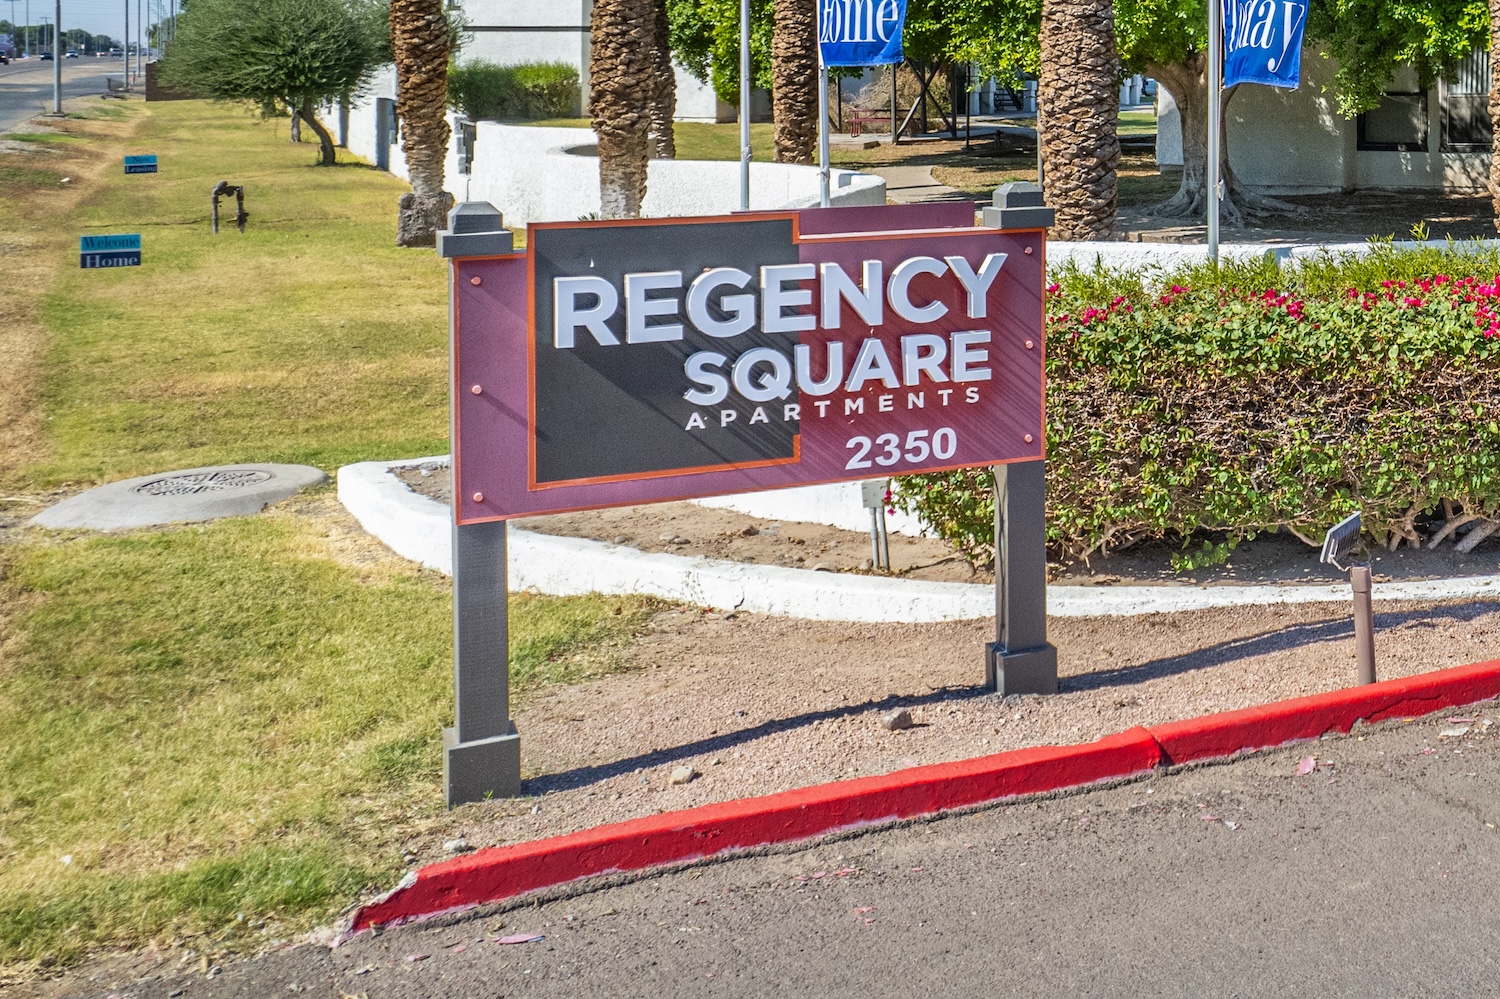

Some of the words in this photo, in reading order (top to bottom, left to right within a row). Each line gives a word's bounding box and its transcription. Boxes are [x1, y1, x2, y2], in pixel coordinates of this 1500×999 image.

[125, 165, 157, 173] Leasing
[83, 236, 139, 249] Welcome
[86, 255, 138, 268] Home
[552, 252, 1009, 349] REGENCY
[683, 330, 993, 406] SQUARE
[684, 386, 981, 431] APARTMENTS
[844, 427, 958, 471] 2350
